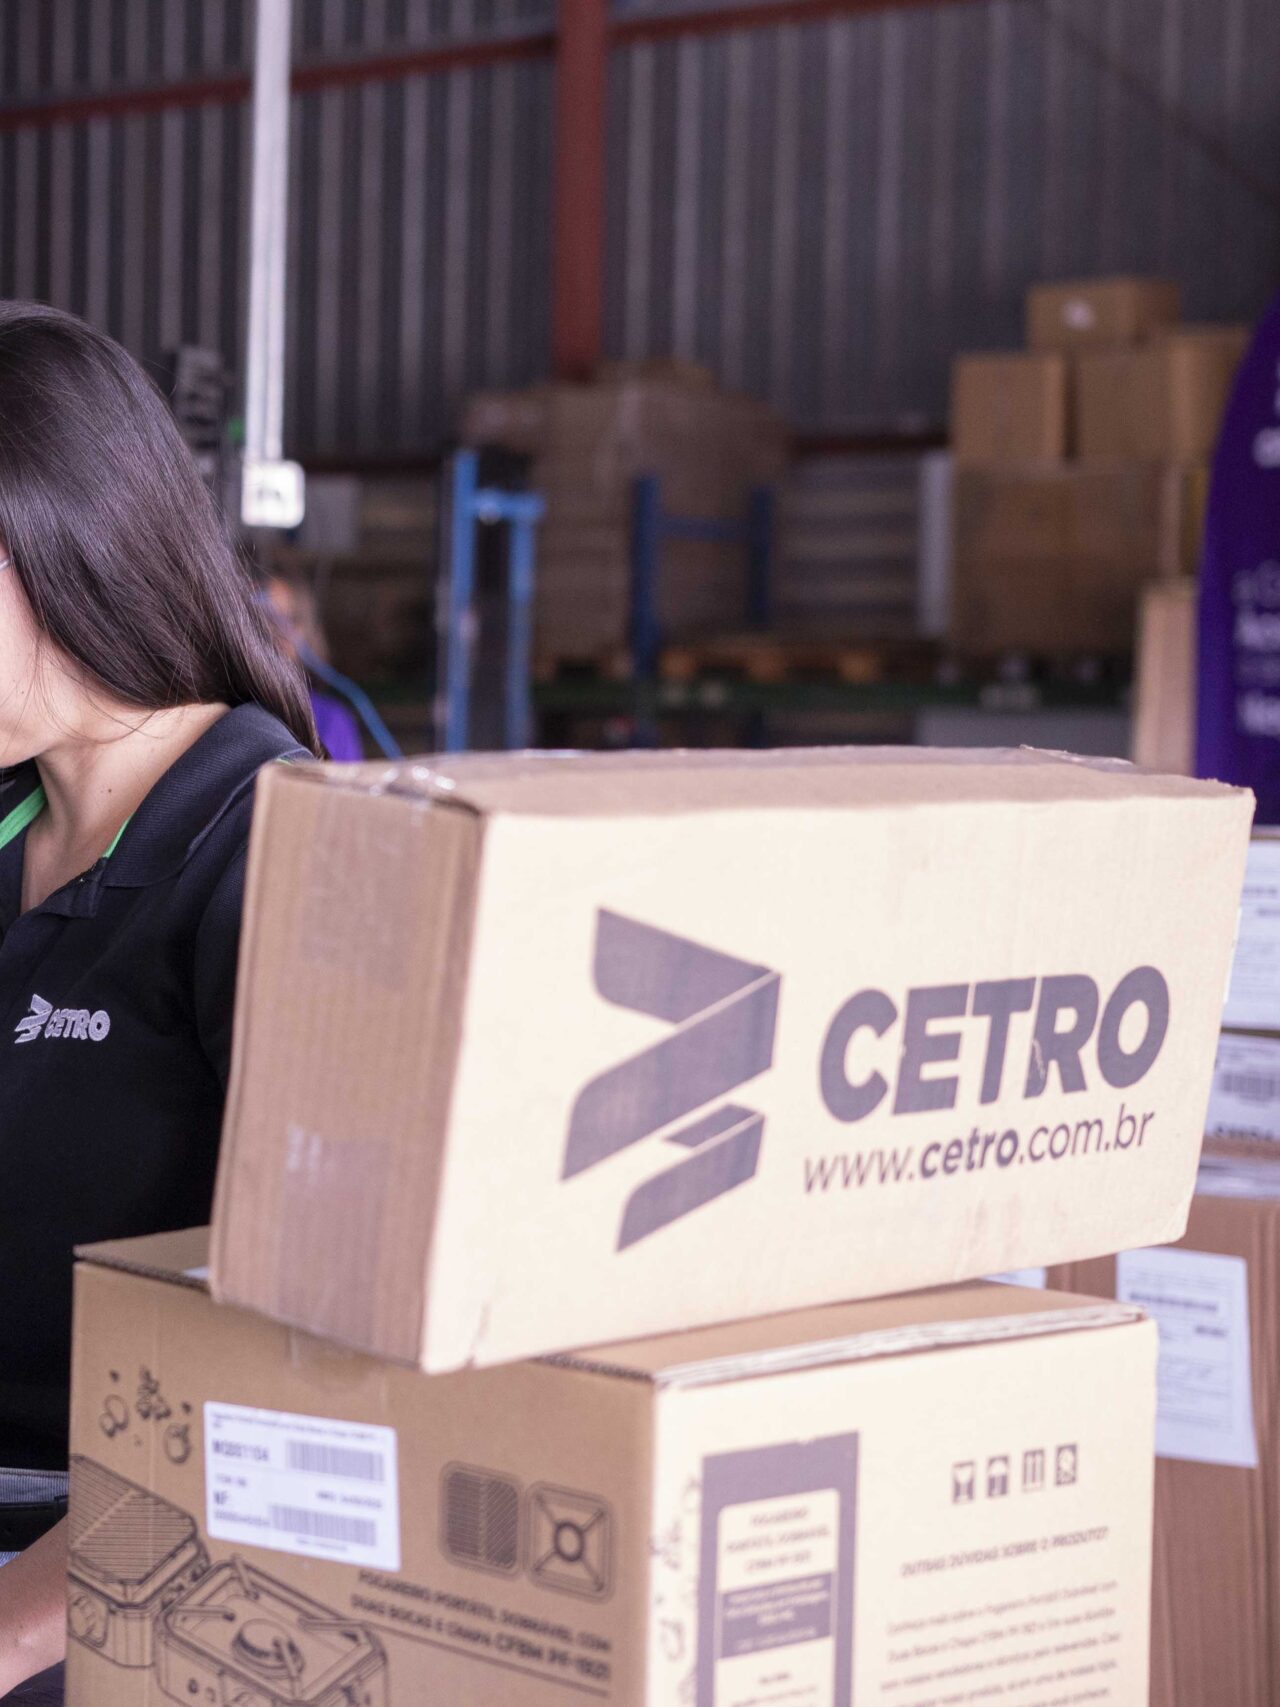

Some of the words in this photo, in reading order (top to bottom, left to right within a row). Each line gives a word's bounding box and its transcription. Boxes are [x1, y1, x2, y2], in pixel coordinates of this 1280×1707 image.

[44, 1008, 111, 1042] CETRO
[819, 965, 1170, 1123] CETRO
[804, 1103, 1155, 1193] www.cetro.com.br
